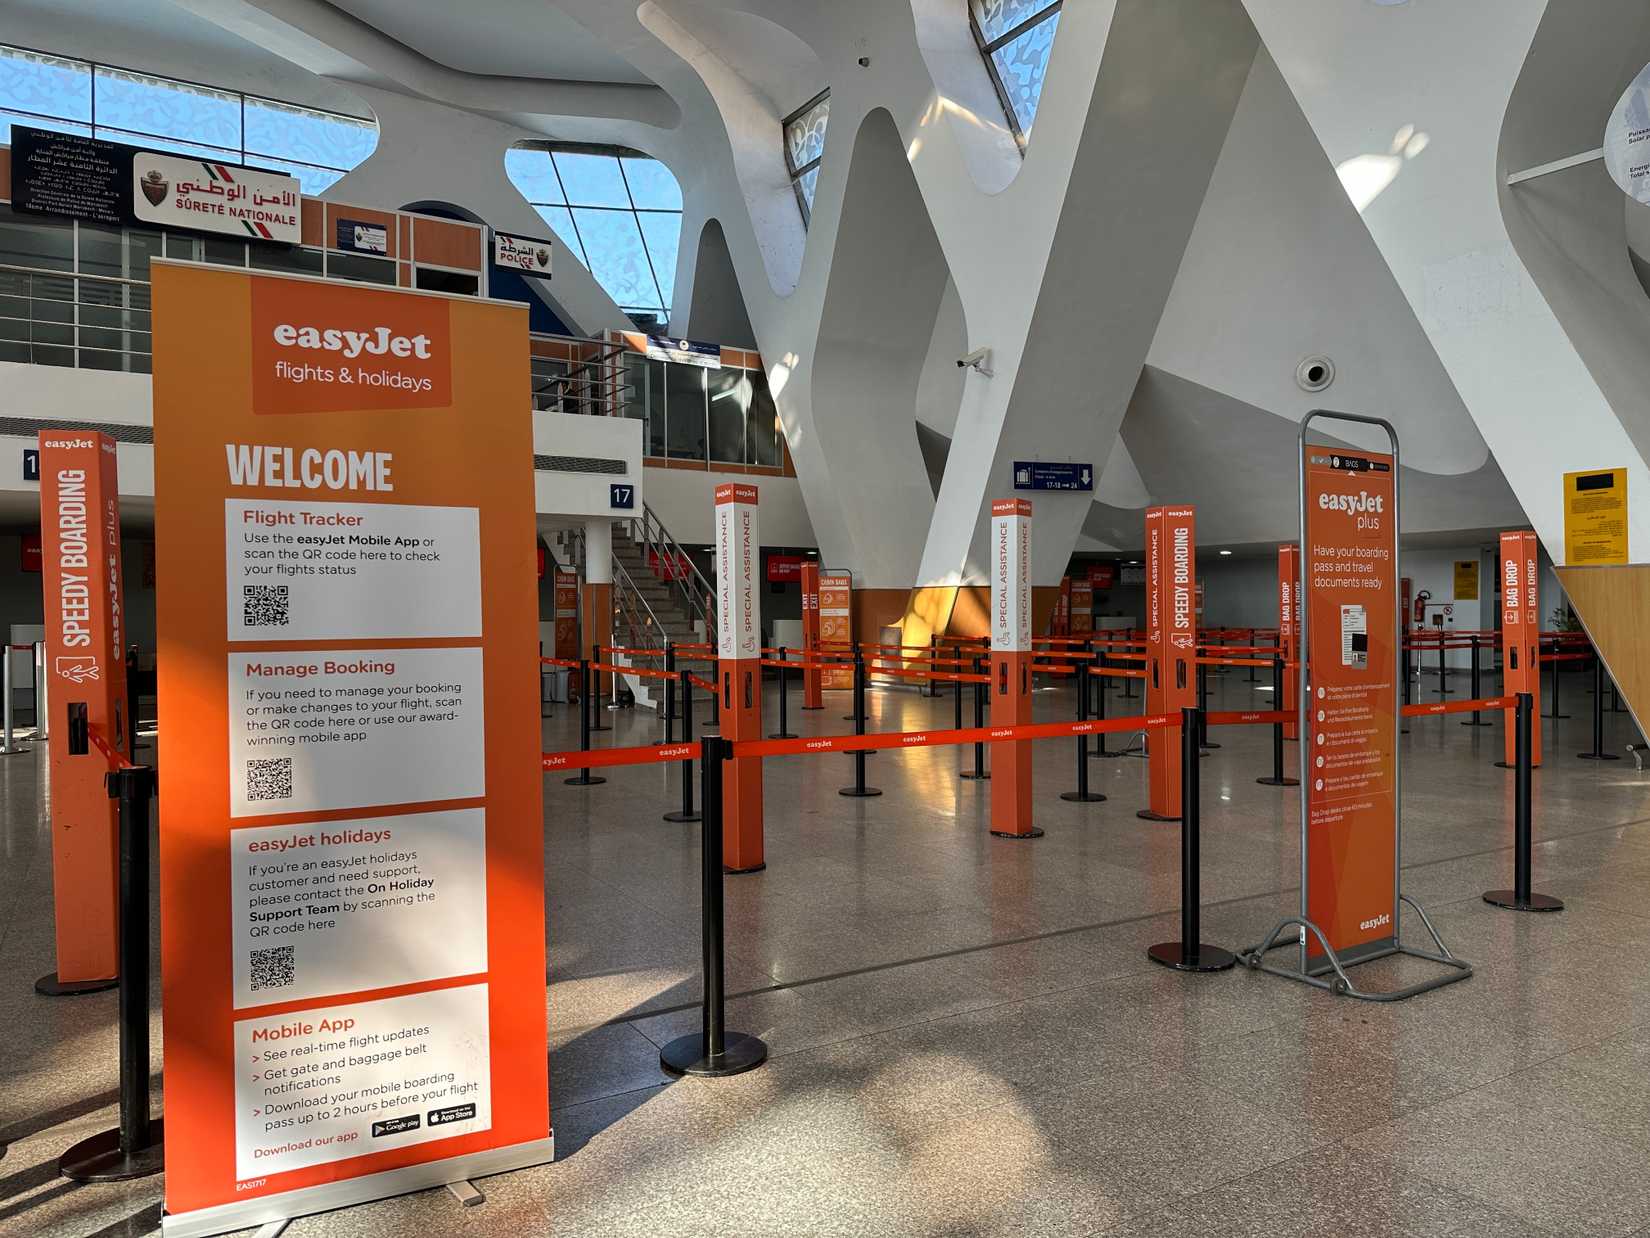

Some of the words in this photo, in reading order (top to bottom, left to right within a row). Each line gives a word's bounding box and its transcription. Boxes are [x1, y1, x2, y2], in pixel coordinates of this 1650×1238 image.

[176, 180, 246, 201] الوطني
[253, 190, 296, 206] الأمن
[176, 198, 224, 215] SÛRETÉ
[229, 207, 296, 226] NATIONALE
[501, 243, 533, 255] الشرطة
[501, 253, 533, 265] POLICE
[274, 324, 431, 359] easyJet
[275, 361, 334, 383] flights
[339, 368, 353, 384] &
[359, 368, 431, 392] holidays
[45, 439, 94, 449] easyJet
[225, 444, 393, 491] WELCOME
[614, 488, 630, 503] 17
[1319, 491, 1383, 515] easyJet
[58, 469, 88, 567] BOARDING
[106, 500, 117, 546] plus
[243, 510, 295, 526] Flight
[301, 512, 363, 525] Tracker
[1358, 512, 1379, 530] plus
[244, 533, 269, 543] Use
[273, 534, 293, 543] the
[297, 535, 344, 546] easyJet
[349, 536, 391, 546] Mobile
[394, 537, 419, 548] App
[244, 550, 274, 559] scan
[278, 550, 299, 559] the
[302, 550, 322, 561] QR
[325, 551, 356, 560] code
[360, 551, 386, 560] here
[390, 552, 402, 561] to
[405, 551, 440, 561] check
[1174, 528, 1188, 583] BOARDING
[1314, 545, 1334, 556] Have
[1337, 549, 1355, 559] your
[1356, 546, 1388, 560] boarding
[245, 566, 272, 576] your
[277, 565, 315, 576] flights
[319, 566, 356, 575] status
[1314, 562, 1333, 573] pass
[1336, 562, 1351, 572] and
[1352, 562, 1374, 573] travel
[1506, 560, 1517, 586] DROP
[1315, 577, 1360, 587] documents
[1360, 579, 1382, 590] ready
[108, 554, 120, 660] easyJet
[1506, 588, 1518, 607] BAG
[61, 573, 90, 646] SPEEDY
[1174, 587, 1189, 628] SPEEDY
[247, 664, 318, 677] Manage
[324, 660, 395, 674] Booking
[246, 690, 254, 700] If
[258, 692, 280, 701] you
[285, 689, 315, 698] need
[320, 689, 332, 697] to
[335, 687, 384, 697] manage
[388, 686, 412, 695] your
[416, 684, 461, 694] booking
[247, 707, 259, 715] or
[263, 705, 297, 714] make
[301, 702, 352, 714] changes
[356, 702, 368, 710] to
[372, 701, 397, 711] your
[401, 699, 432, 709] flight,
[435, 698, 462, 707] scan
[247, 721, 267, 730] the
[272, 720, 289, 729] QR
[294, 718, 324, 728] code
[329, 717, 355, 726] here
[359, 717, 371, 725] or
[374, 716, 394, 724] use
[398, 714, 416, 723] our
[419, 712, 459, 722] award-
[247, 734, 295, 745] winning
[299, 732, 340, 743] mobile
[344, 732, 366, 742] app
[806, 740, 832, 749] easyJet
[903, 735, 926, 743] easyJet
[659, 747, 689, 756] easyJet
[249, 835, 314, 852] easyJet
[321, 829, 391, 845] holidays
[249, 866, 257, 875] If
[260, 863, 298, 876] you're
[302, 862, 317, 870] an
[321, 856, 366, 868] easyJet
[370, 851, 417, 863] holidays
[249, 877, 309, 891] customer
[312, 874, 335, 884] and
[338, 871, 368, 882] need
[372, 865, 420, 879] support,
[250, 893, 290, 908] please
[294, 889, 341, 902] contact
[345, 886, 364, 896] the
[368, 884, 385, 894] On
[390, 878, 434, 891] Holiday
[250, 909, 302, 922] Support
[306, 903, 339, 915] Team
[343, 902, 358, 912] by
[361, 896, 413, 909] scanning
[417, 892, 435, 902] the
[250, 927, 269, 937] QR
[273, 923, 304, 934] code
[308, 920, 335, 930] here
[1360, 915, 1389, 930] easyJet
[252, 1022, 313, 1042] Mobile
[319, 1017, 354, 1032] App
[264, 1050, 287, 1062] See
[291, 1041, 345, 1056] real-time
[350, 1035, 379, 1048] flight
[383, 1025, 430, 1042] updates
[264, 1069, 287, 1080] Get
[291, 1064, 318, 1077] gate
[323, 1059, 345, 1070] and
[349, 1049, 402, 1066] baggage
[406, 1044, 426, 1055] belt
[264, 1076, 341, 1096] notifications
[265, 1094, 328, 1115] Download
[331, 1089, 359, 1104] your
[361, 1082, 401, 1098] mobile
[404, 1073, 454, 1090] boarding
[265, 1118, 294, 1132] pass
[298, 1113, 314, 1125] up
[317, 1111, 330, 1120] to
[334, 1106, 340, 1118] 2
[344, 1102, 378, 1116] hours
[381, 1092, 419, 1109] before
[422, 1088, 447, 1103] your
[451, 1082, 479, 1094] flight
[386, 1122, 406, 1131] Google
[254, 1140, 312, 1158] Download
[316, 1136, 334, 1146] our
[337, 1132, 358, 1144] app
